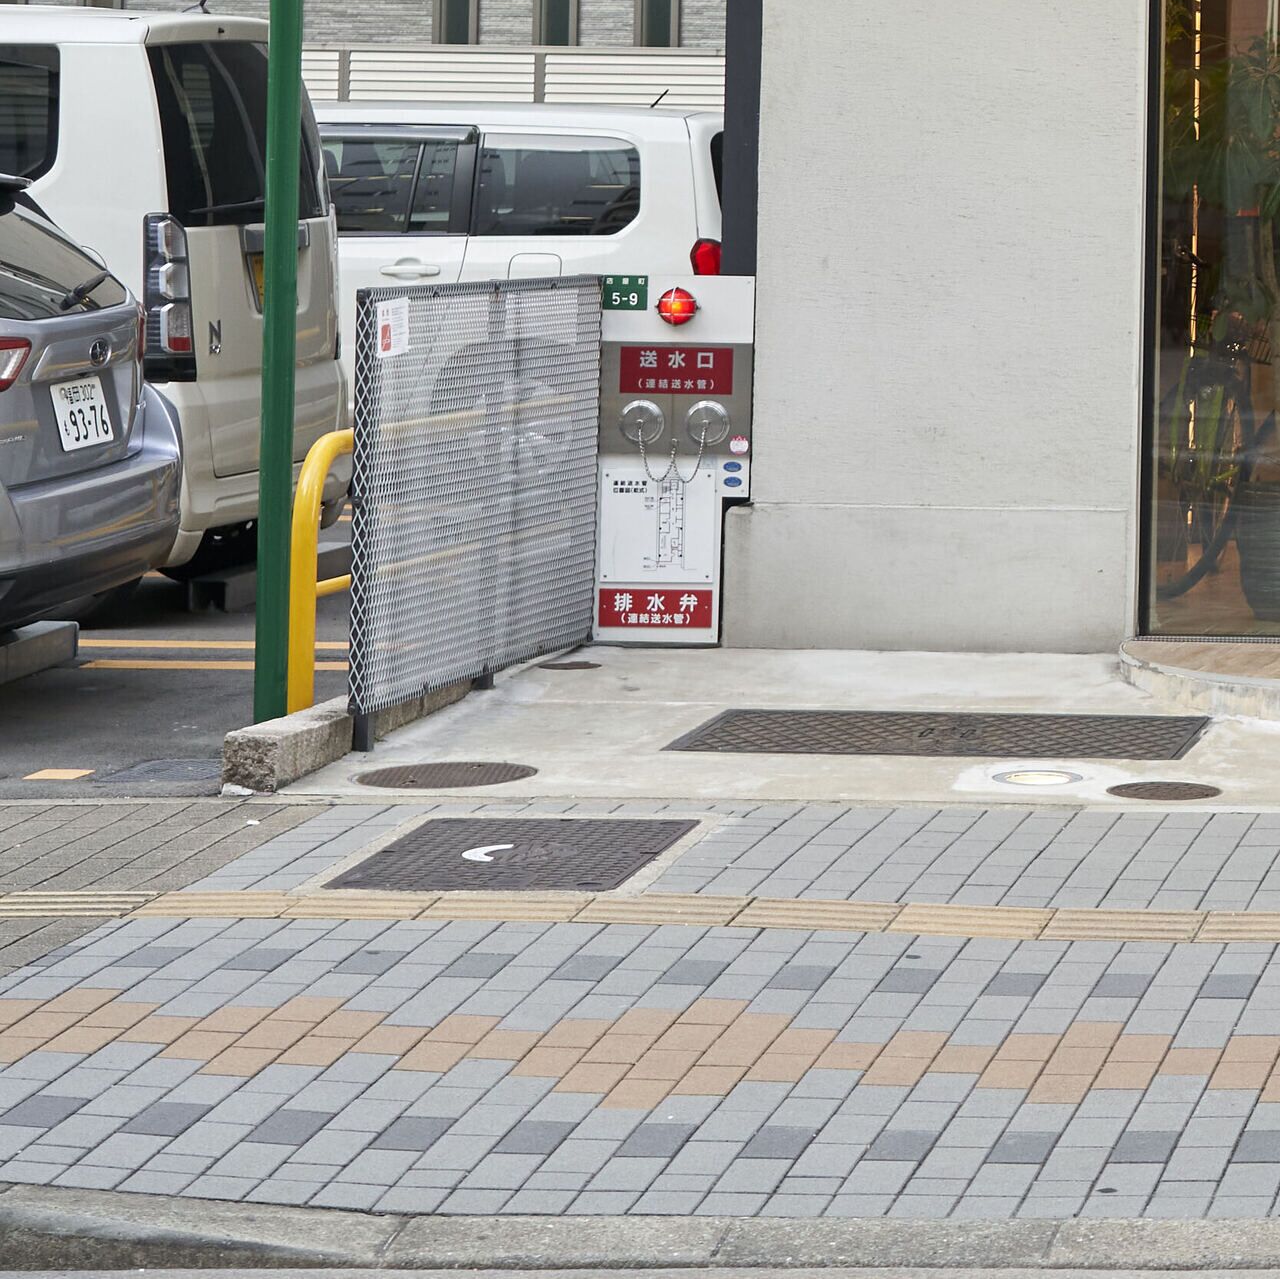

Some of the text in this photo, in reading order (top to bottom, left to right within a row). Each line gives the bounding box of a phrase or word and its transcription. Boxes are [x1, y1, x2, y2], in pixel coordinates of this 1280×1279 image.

[611, 293, 638, 305] 5-9
[639, 350, 714, 368] 送水口
[613, 592, 699, 612] 排水弁
